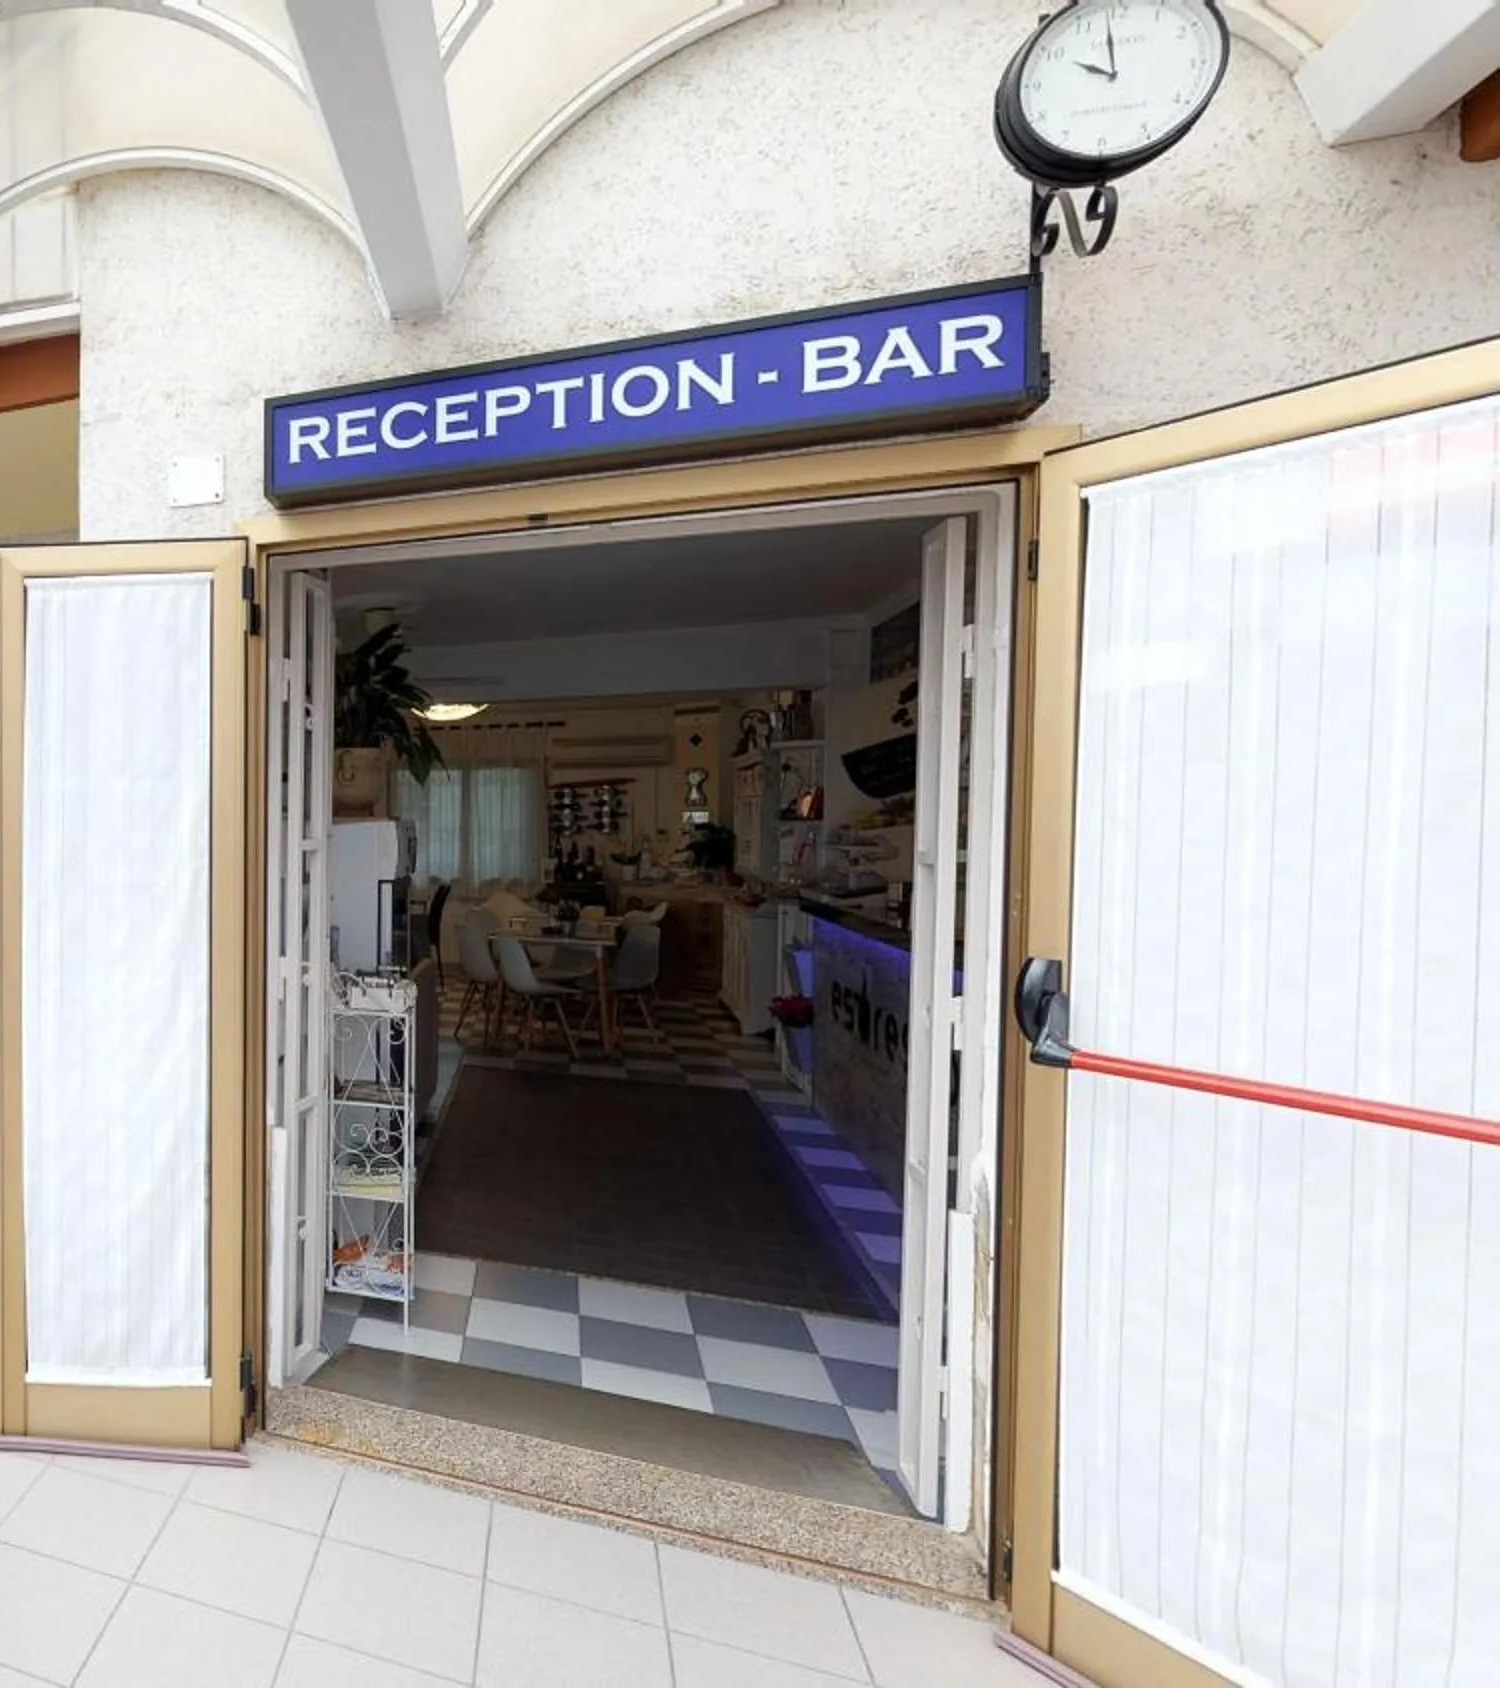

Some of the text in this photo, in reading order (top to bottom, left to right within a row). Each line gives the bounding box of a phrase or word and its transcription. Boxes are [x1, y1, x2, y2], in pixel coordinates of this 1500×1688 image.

[1091, 34, 1146, 50] LODON
[1046, 46, 1065, 61] 10
[287, 352, 735, 465] RECEPTION
[801, 312, 1006, 394] BAR
